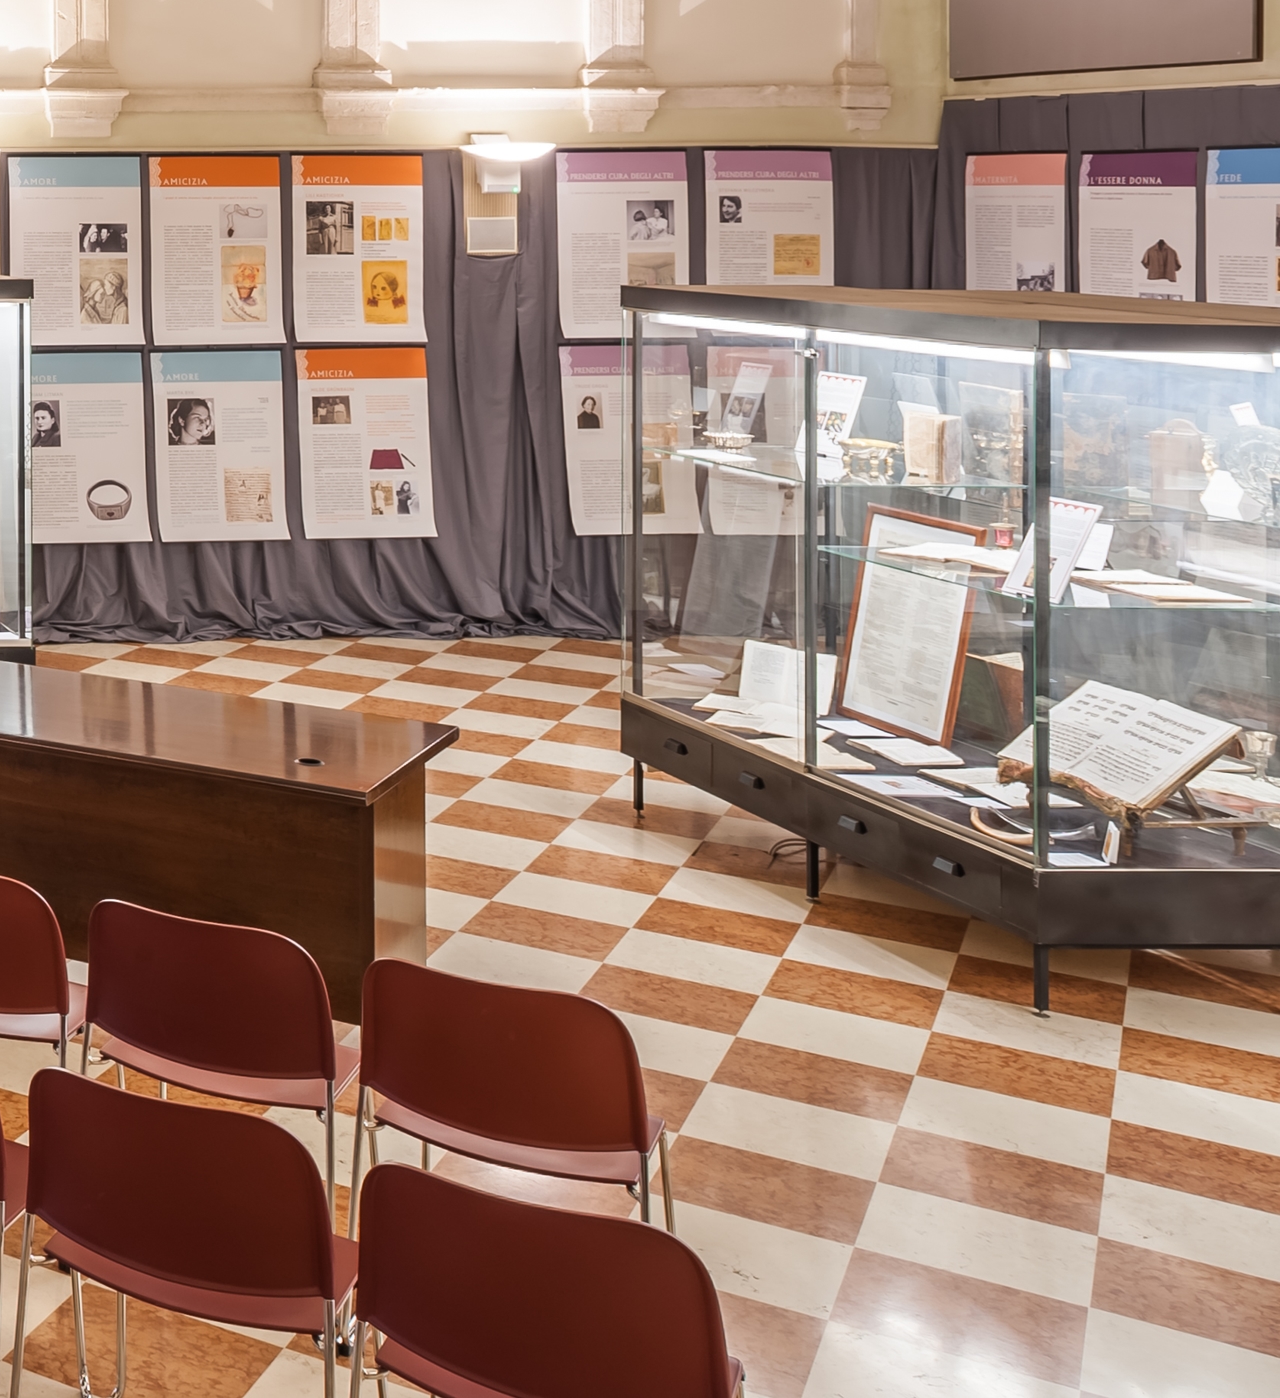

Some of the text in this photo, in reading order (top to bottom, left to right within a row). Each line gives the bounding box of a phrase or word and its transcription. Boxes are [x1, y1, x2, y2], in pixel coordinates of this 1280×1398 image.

[570, 172, 607, 180] PRENDERSI
[798, 171, 820, 179] ALTRI
[1220, 173, 1242, 182] FEDE
[305, 176, 351, 184] AMICIZIA
[1090, 176, 1162, 185] L'ESSERE DONNA
[310, 370, 354, 378] AMICIZIA
[573, 366, 610, 374] PRENDERSI
[165, 373, 199, 381] AMORE
